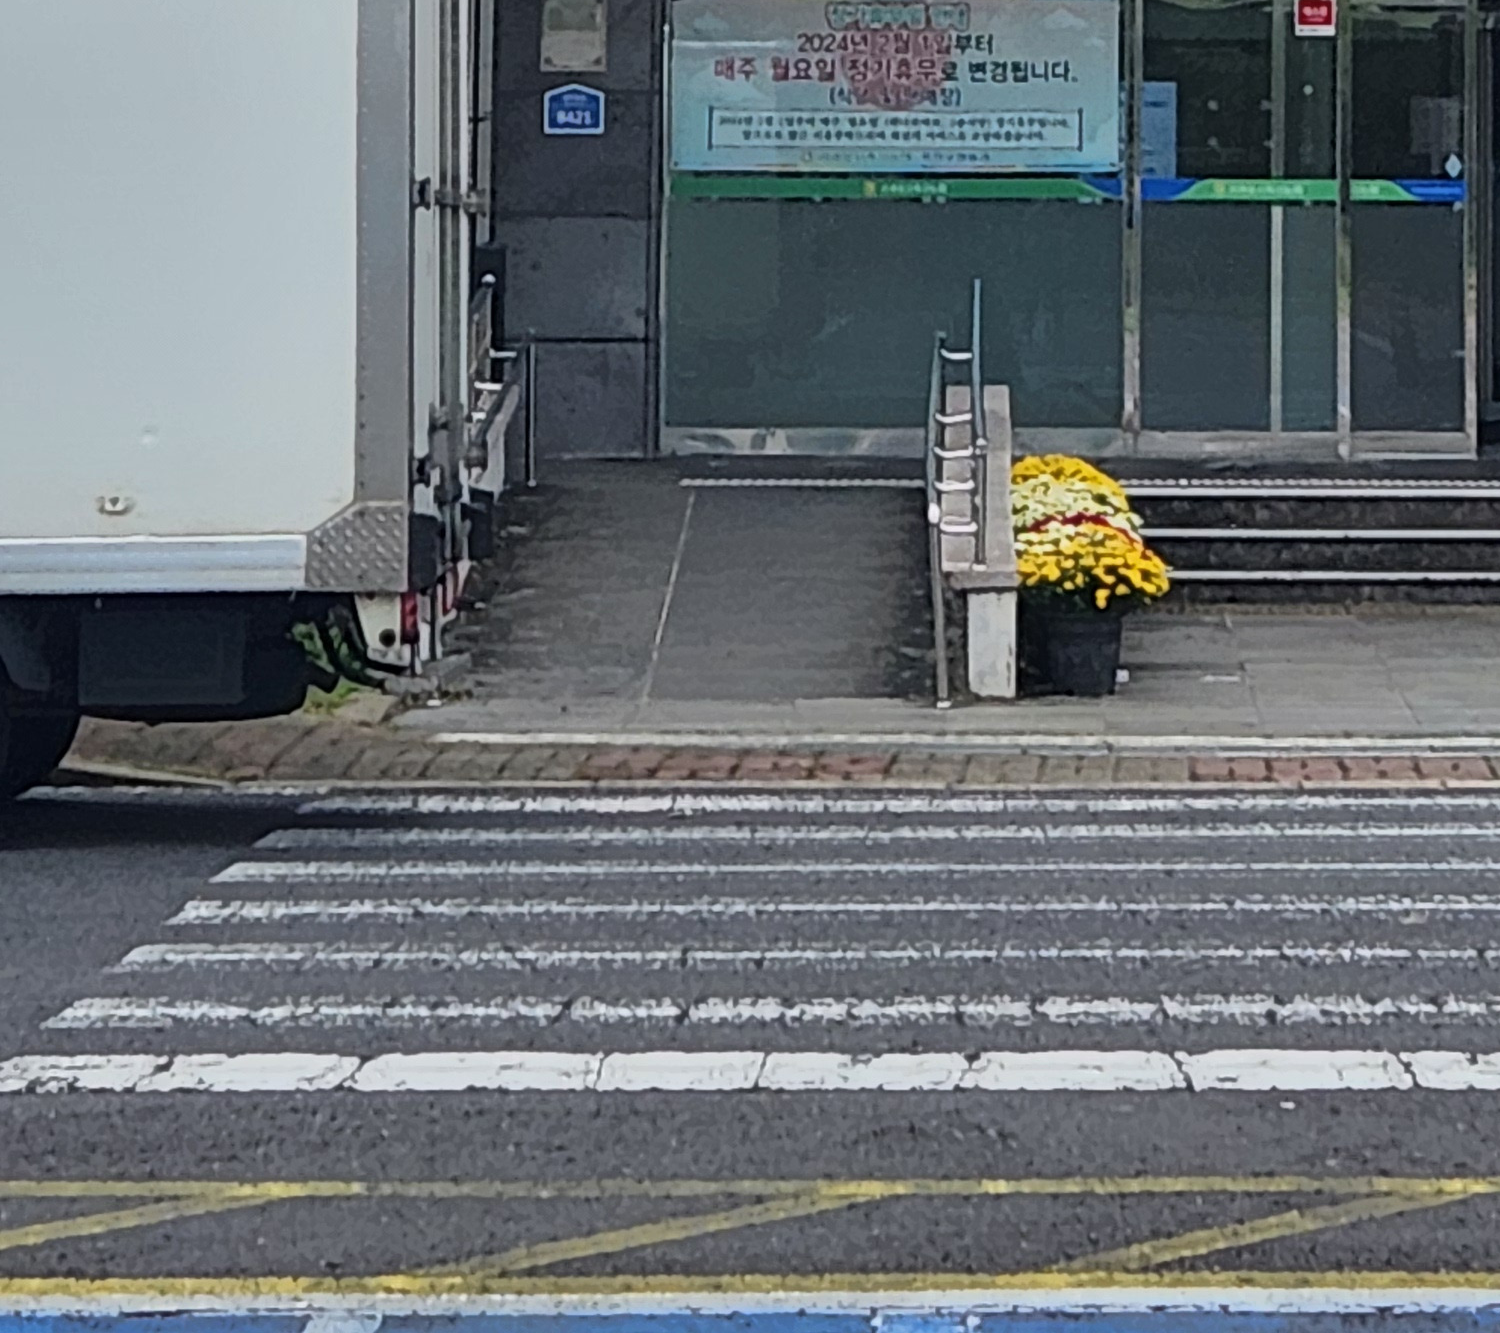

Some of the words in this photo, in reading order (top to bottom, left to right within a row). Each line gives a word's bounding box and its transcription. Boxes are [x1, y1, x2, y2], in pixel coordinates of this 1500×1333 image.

[798, 33, 869, 54] 2024년
[714, 56, 759, 81] 매주
[770, 56, 836, 82] 월요일
